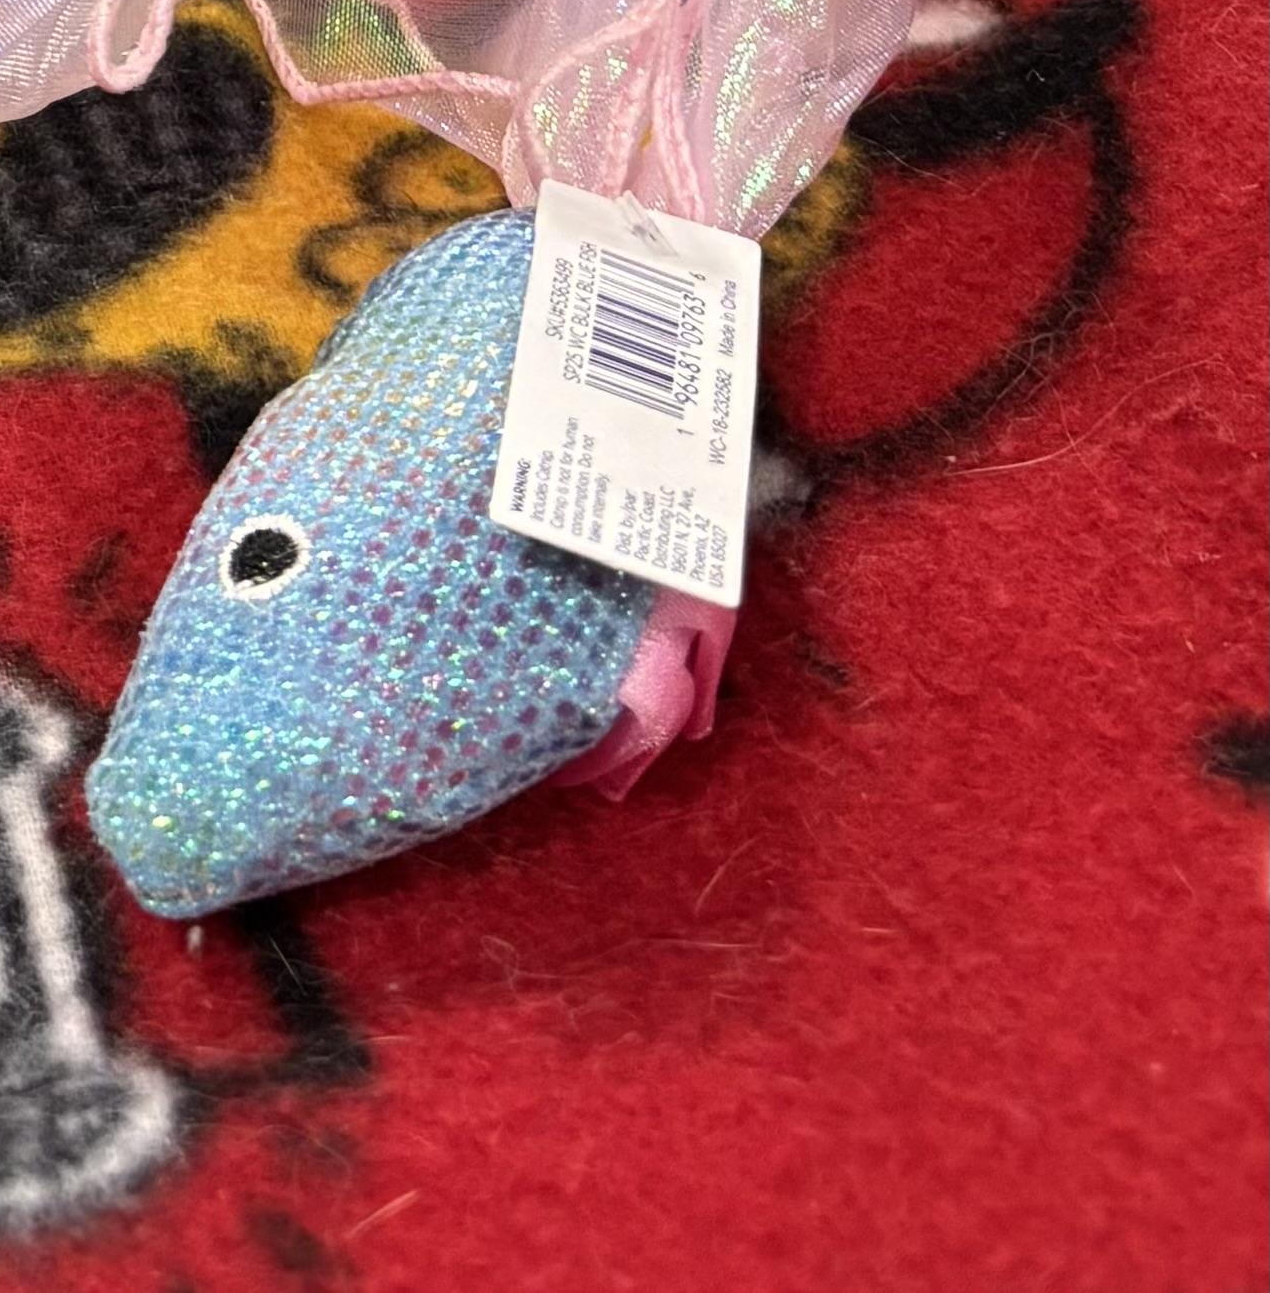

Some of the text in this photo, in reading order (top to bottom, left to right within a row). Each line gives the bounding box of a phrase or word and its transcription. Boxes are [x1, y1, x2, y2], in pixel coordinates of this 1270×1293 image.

[575, 261, 596, 294] BLUE
[570, 292, 591, 327] BULK
[567, 326, 587, 350] WC
[717, 324, 735, 357] Made
